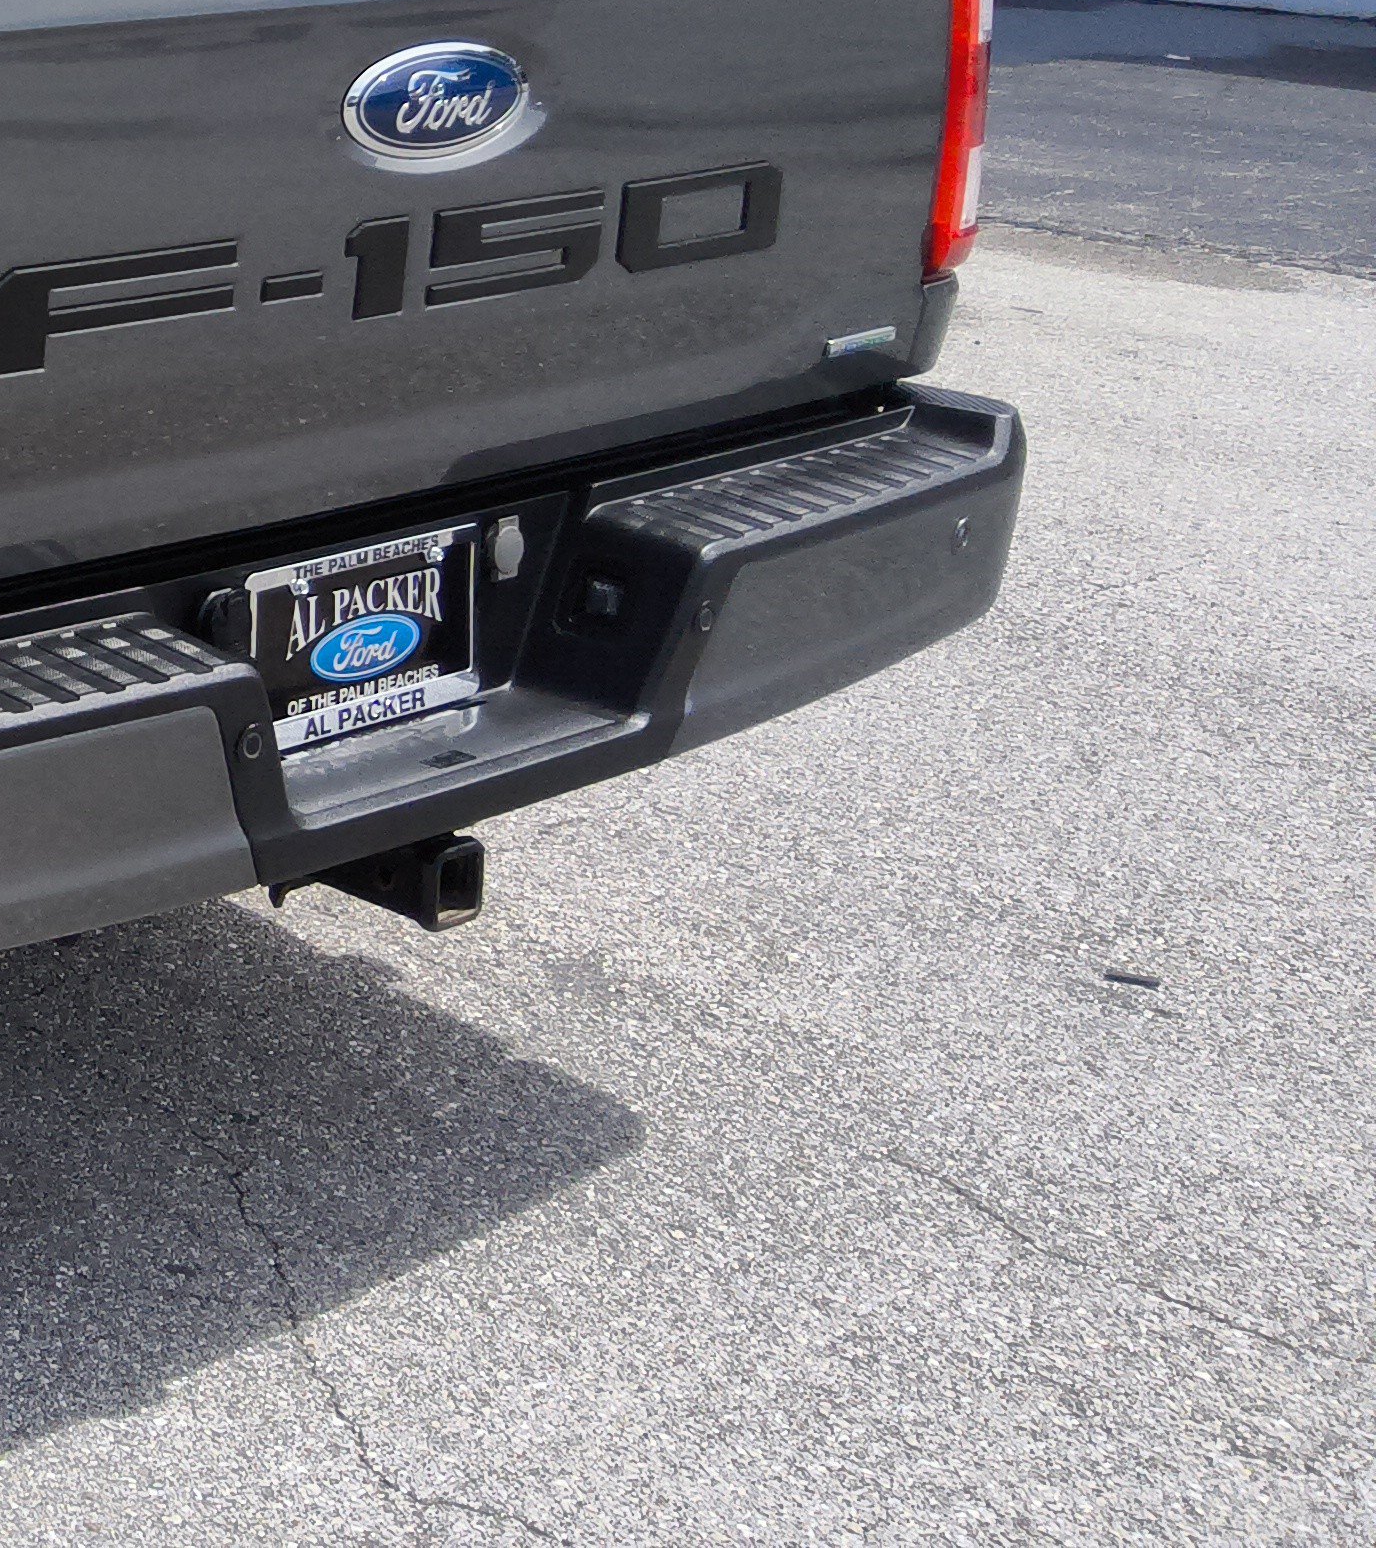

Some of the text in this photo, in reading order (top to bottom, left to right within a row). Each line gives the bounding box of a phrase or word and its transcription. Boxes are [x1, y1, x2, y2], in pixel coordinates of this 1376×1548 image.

[396, 68, 495, 134] Ford
[292, 562, 324, 580] THE
[373, 535, 439, 562] BEACHES
[285, 568, 442, 661] AL PACKER
[333, 626, 398, 671] Ford
[287, 664, 439, 716] OF THE PALM BEACHES
[304, 689, 427, 740] AL PACKER
